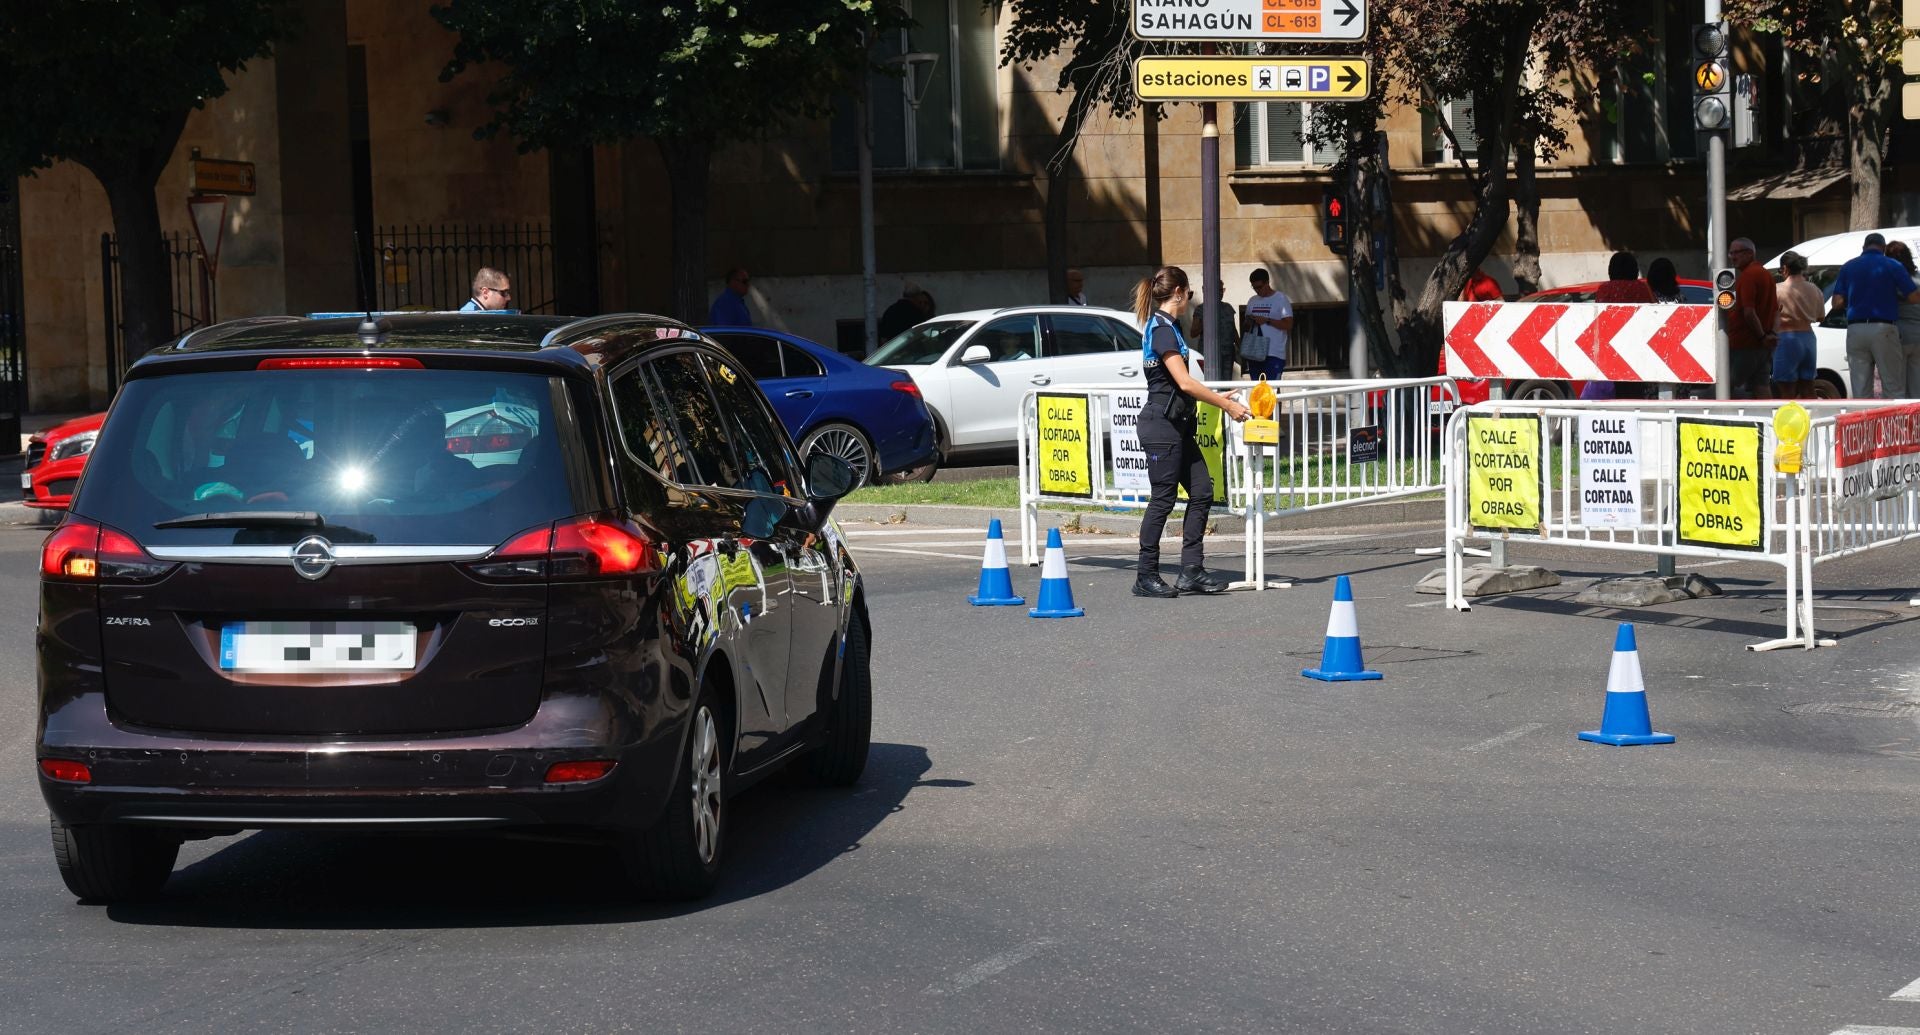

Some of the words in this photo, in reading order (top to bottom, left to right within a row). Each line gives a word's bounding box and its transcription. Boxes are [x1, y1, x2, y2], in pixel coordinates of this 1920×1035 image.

[1141, 9, 1252, 30] SAHAGÚN
[1266, 15, 1285, 28] CL
[1289, 15, 1317, 28] -613
[1142, 71, 1247, 86] estaciones
[1311, 68, 1328, 89] P
[1118, 396, 1142, 409] CALLE
[1047, 407, 1073, 421] CALLE
[1113, 414, 1139, 426] CORTA
[1591, 419, 1626, 434] CALLE
[1043, 427, 1081, 443] CORTADA
[1480, 430, 1517, 445] CALLE
[1352, 440, 1376, 453] elecnor
[1583, 440, 1633, 455] CORTADA
[1696, 437, 1735, 455] CALLE
[1052, 448, 1070, 462] POR
[1474, 452, 1530, 469] CORTADA
[1049, 468, 1077, 483] OBRAS
[1593, 468, 1627, 483] CALLE
[1686, 461, 1749, 481] CORTADA
[1489, 477, 1513, 492] POR
[1584, 489, 1634, 504] CORTADA
[1702, 488, 1730, 505] POR
[1481, 501, 1524, 516] OBRAS
[1695, 514, 1743, 532] OBRAS
[105, 616, 151, 626] ZAFIRA
[225, 650, 233, 660] E
